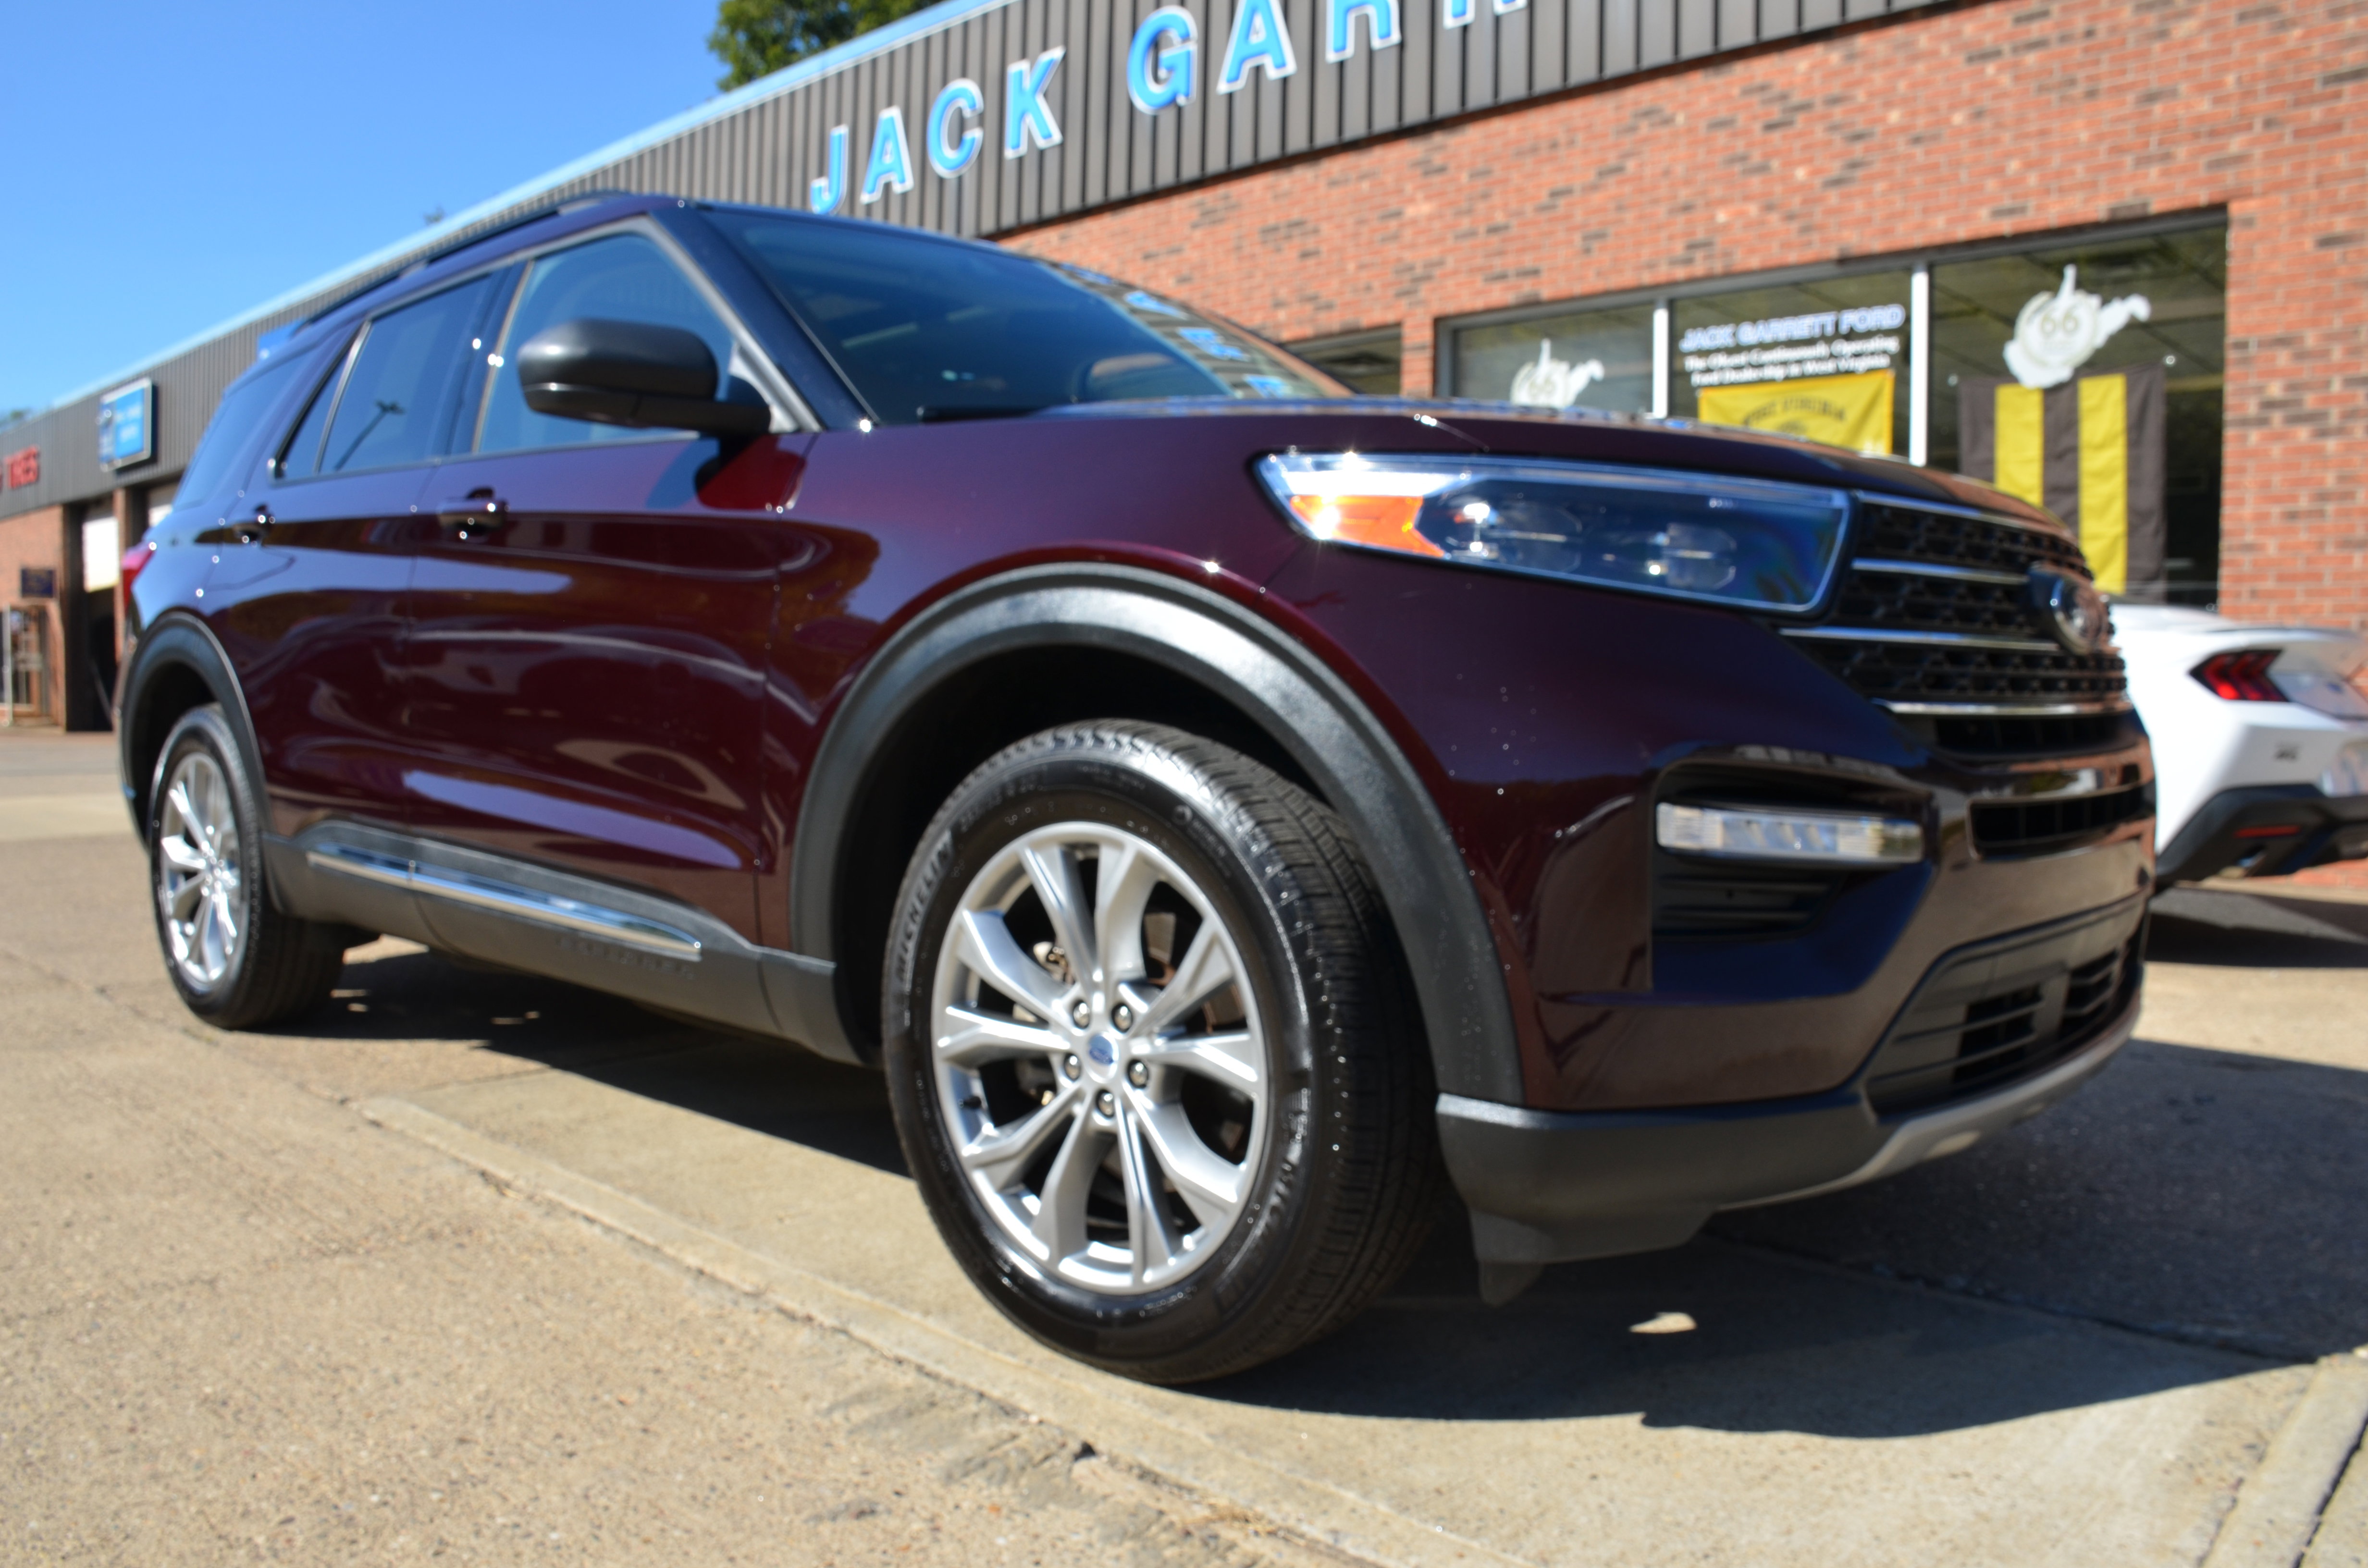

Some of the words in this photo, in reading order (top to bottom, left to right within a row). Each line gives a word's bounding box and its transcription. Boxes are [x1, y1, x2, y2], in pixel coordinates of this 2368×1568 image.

[810, 45, 1066, 215] JACK
[1678, 323, 1738, 354] JACK
[1735, 311, 1838, 346] GARRETT
[1838, 303, 1906, 335] FORD
